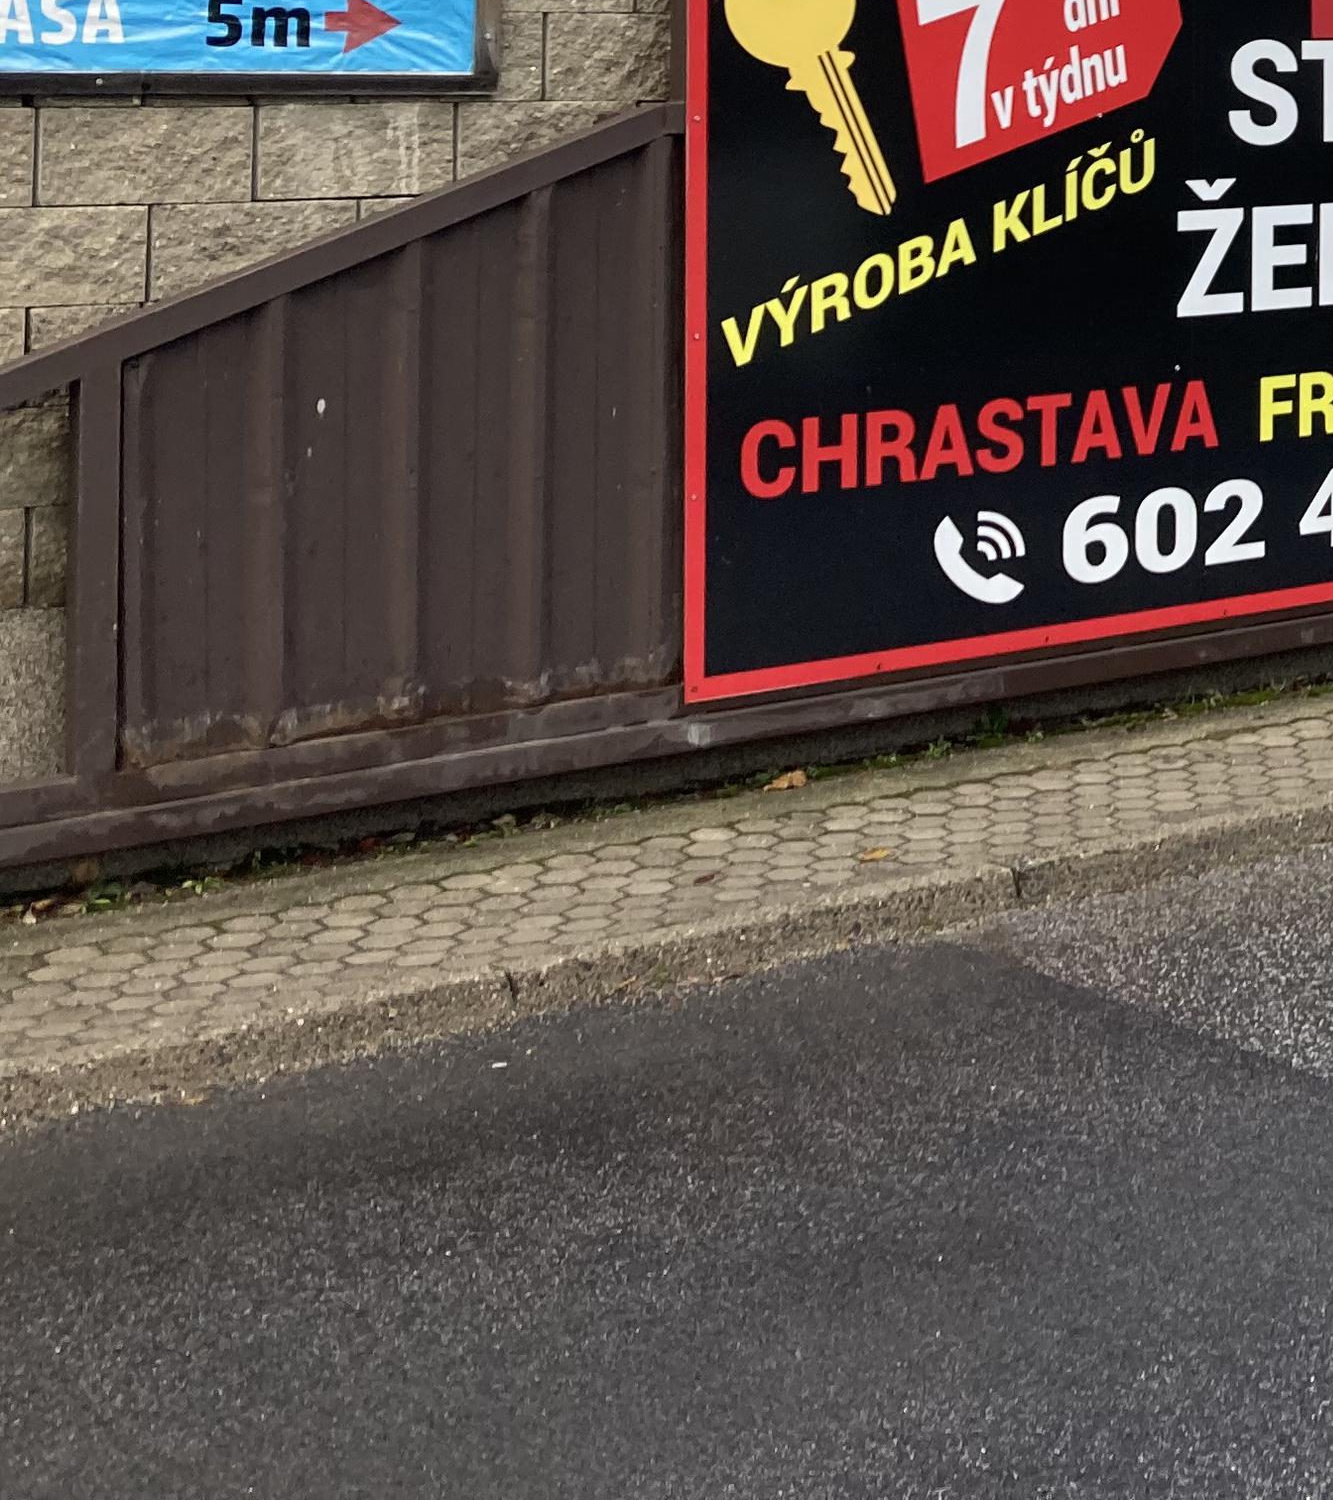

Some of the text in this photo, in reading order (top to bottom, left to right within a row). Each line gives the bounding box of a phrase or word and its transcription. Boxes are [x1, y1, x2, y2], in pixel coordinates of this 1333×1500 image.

[991, 44, 1128, 129] v týdnu
[721, 128, 1156, 367] VÝROBA KLÍČŮ
[740, 381, 1219, 499] CHRASTAVA
[1062, 478, 1266, 584] 602
